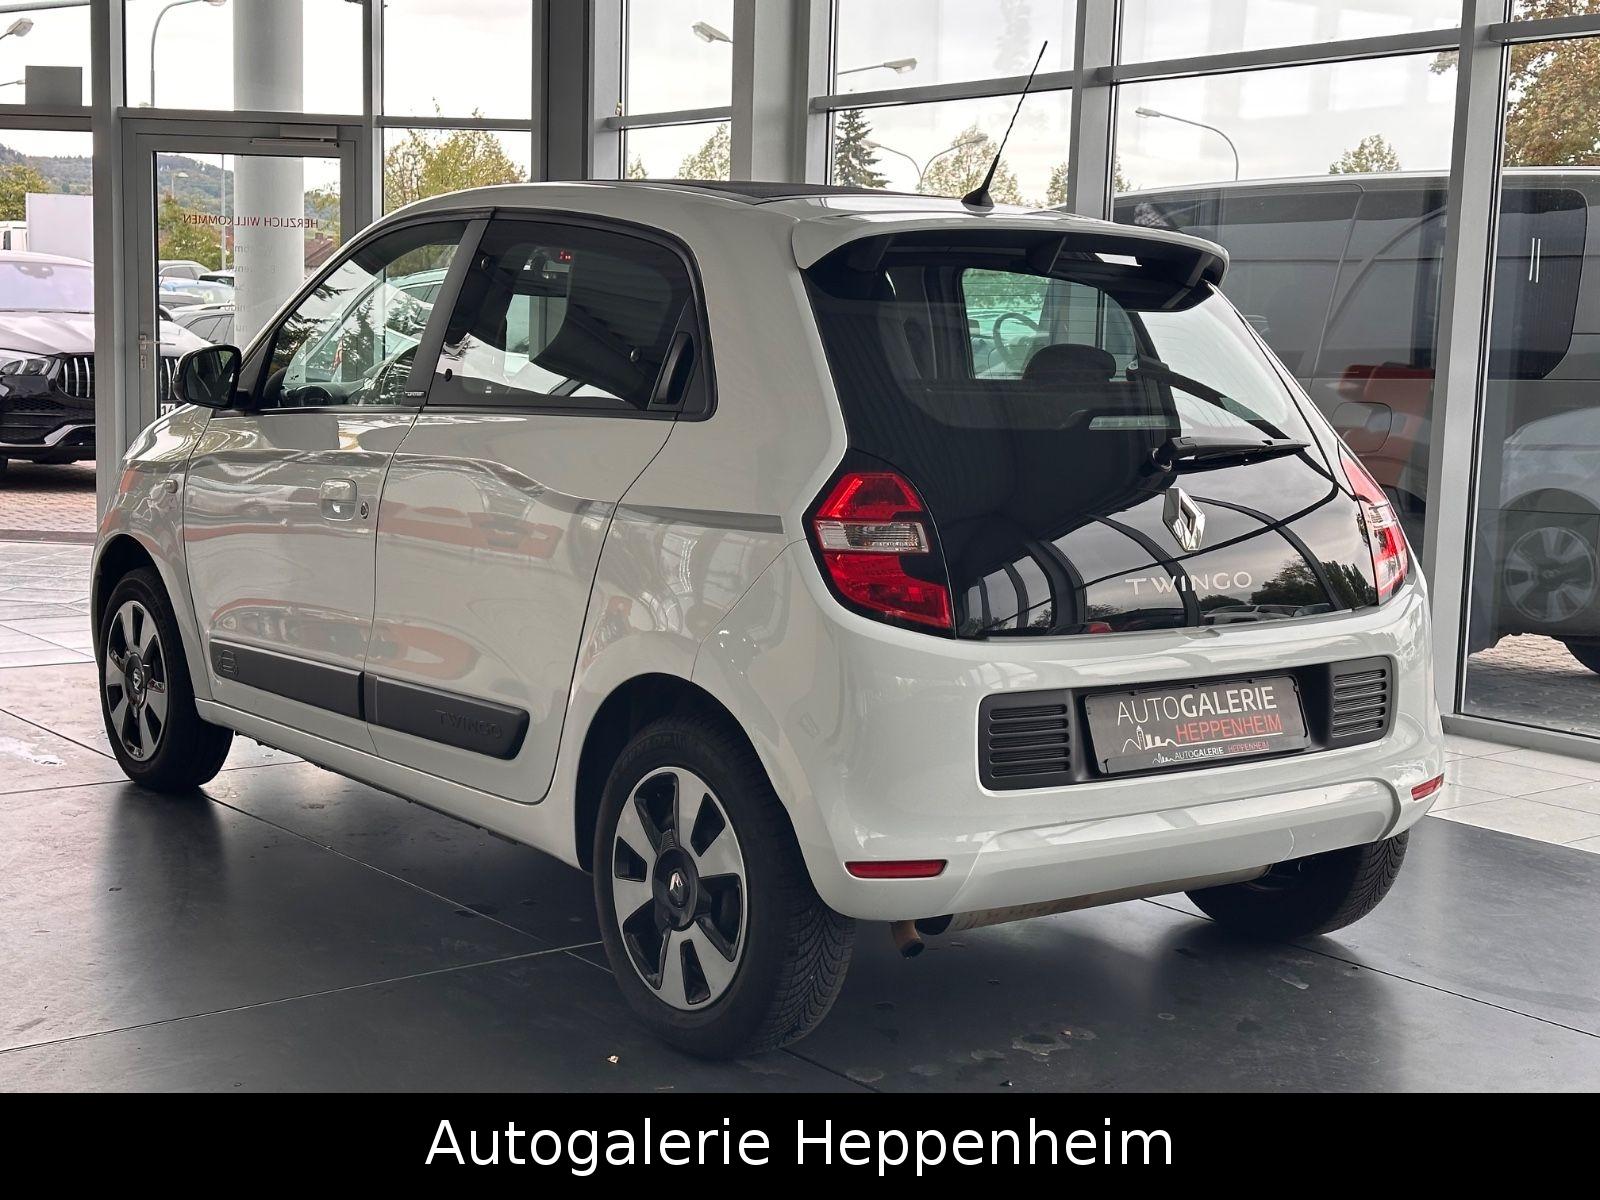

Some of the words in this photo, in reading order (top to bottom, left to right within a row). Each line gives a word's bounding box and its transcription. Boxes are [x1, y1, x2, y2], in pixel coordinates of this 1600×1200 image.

[1125, 571, 1252, 595] TWINGO
[1117, 686, 1277, 726] AUTOGALERIE
[433, 708, 503, 738] TWINGO
[1176, 713, 1282, 742] HEPPENHEIM
[1174, 747, 1224, 759] AUTOGALERIE
